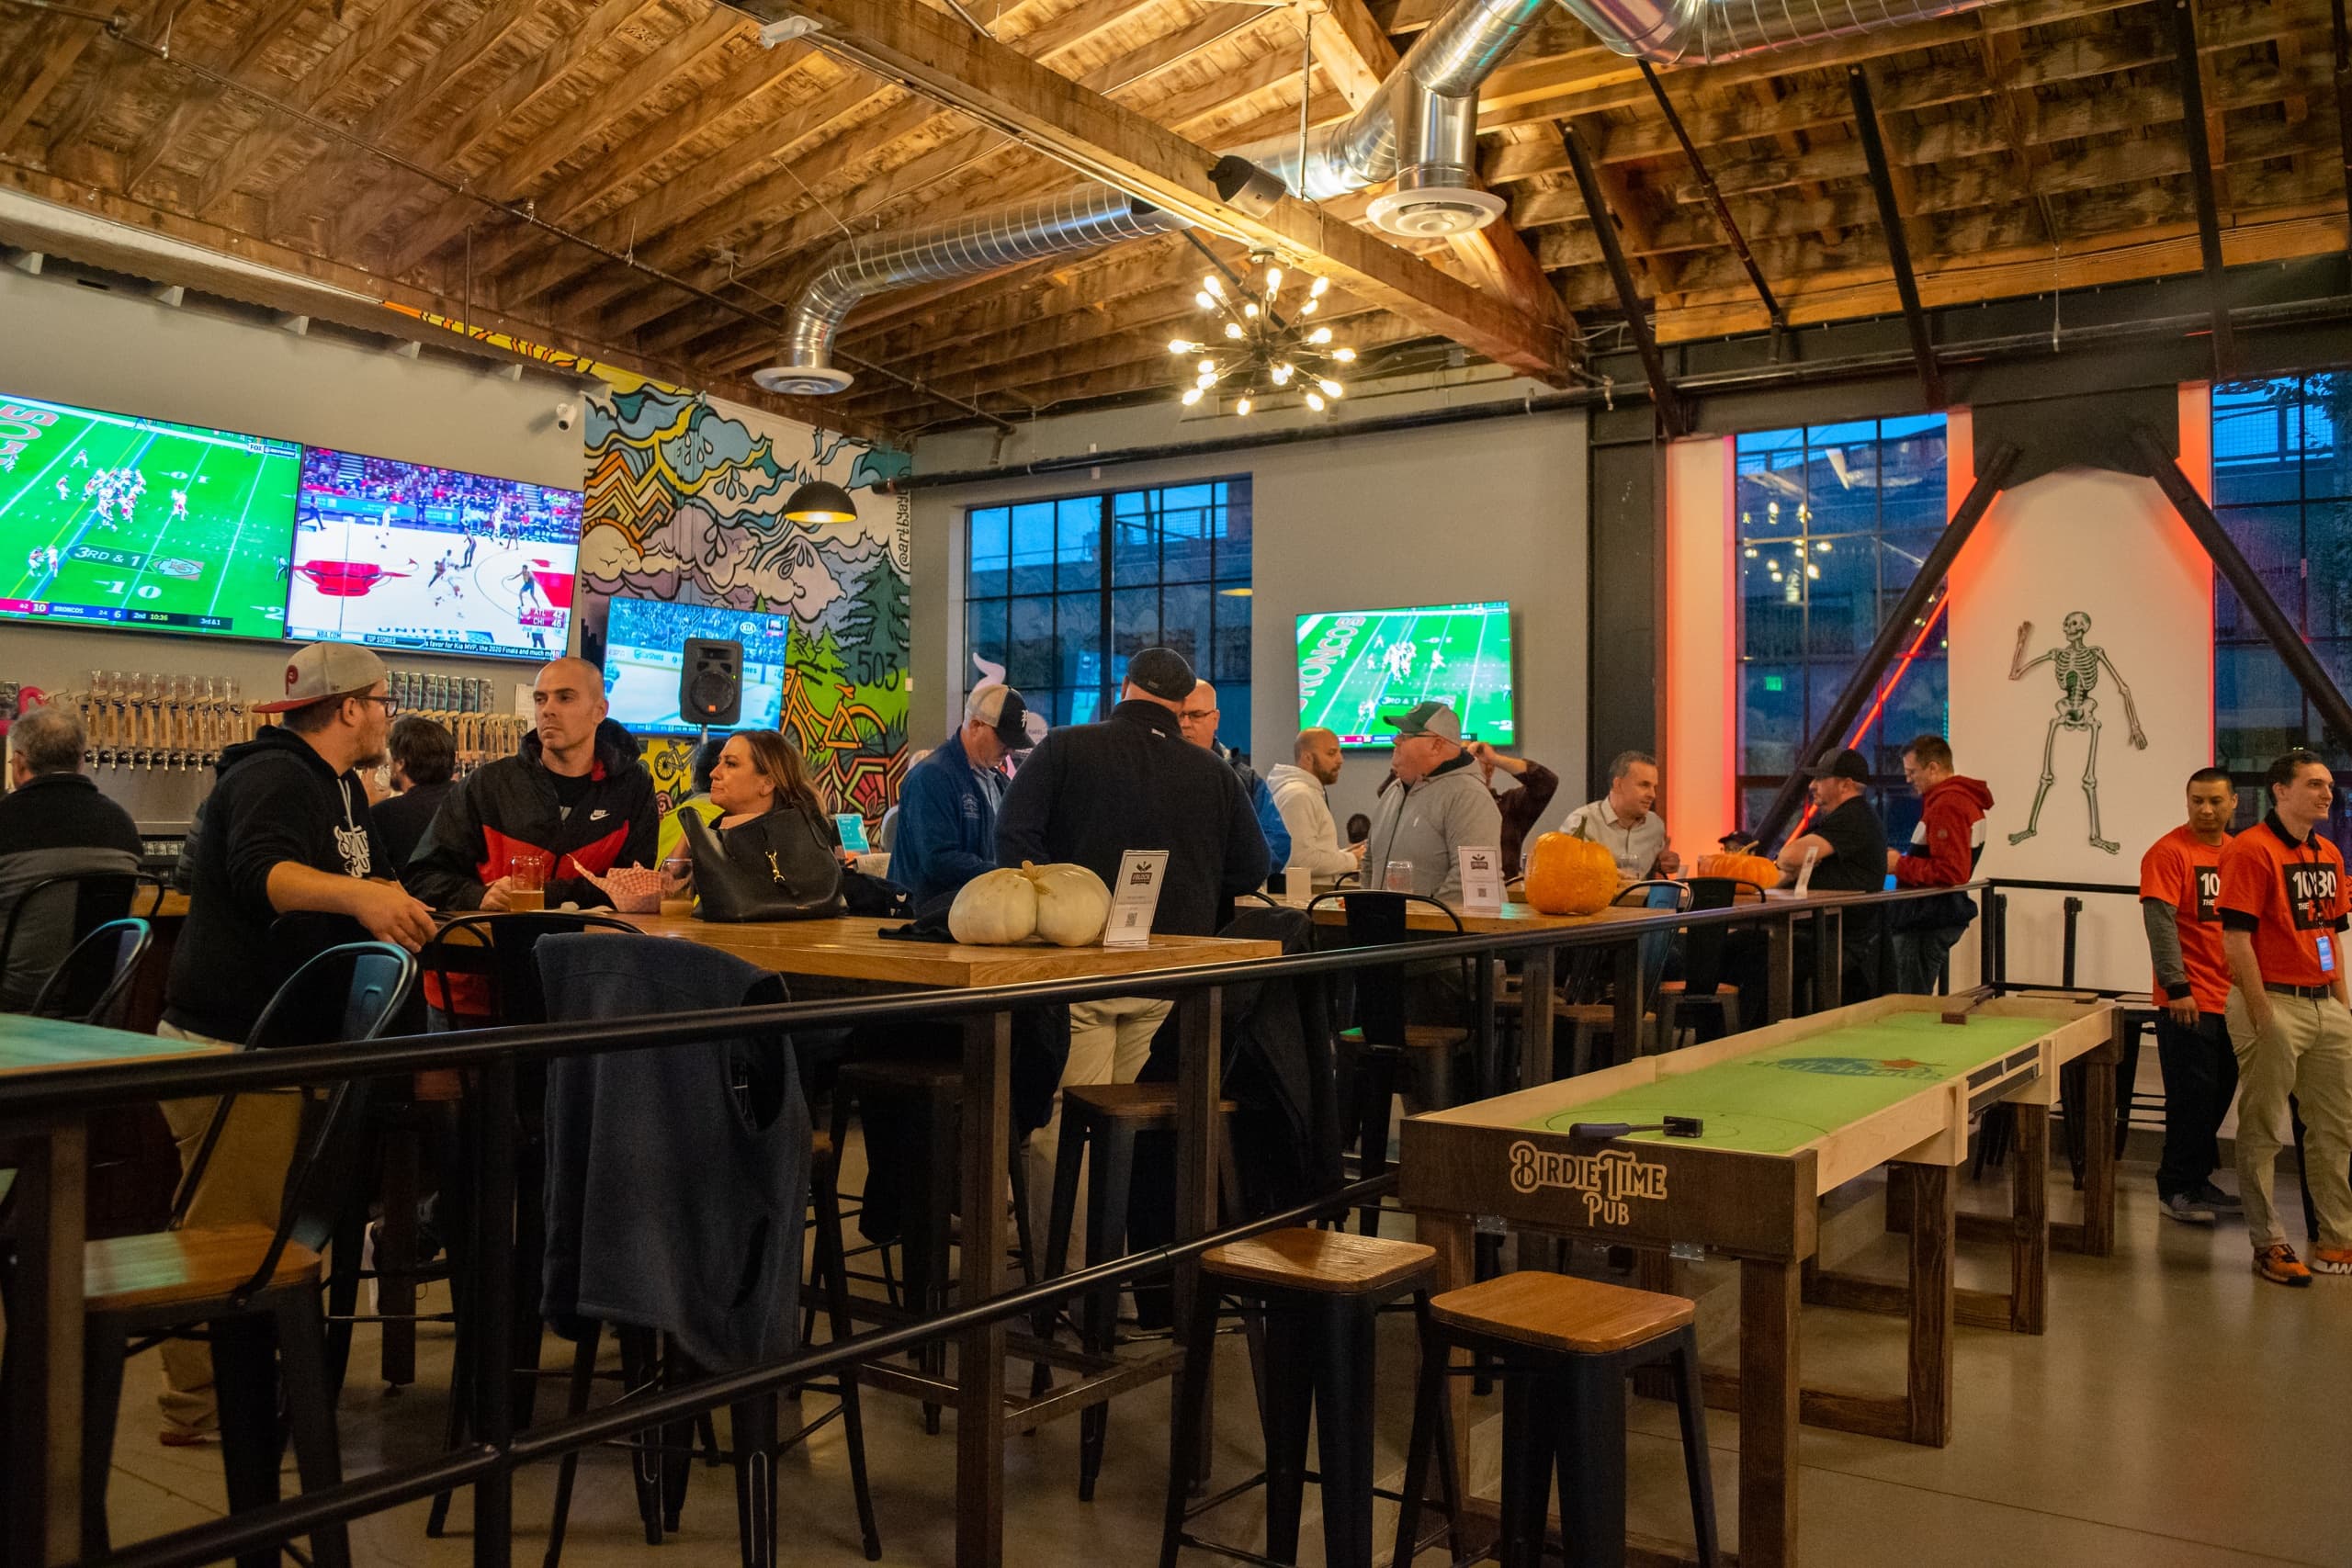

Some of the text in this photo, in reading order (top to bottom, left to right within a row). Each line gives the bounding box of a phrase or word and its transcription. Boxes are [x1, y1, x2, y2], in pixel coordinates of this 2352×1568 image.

[897, 490, 910, 567] @artbyay
[74, 547, 141, 567] 3RD & 1
[32, 603, 47, 612] 10
[53, 605, 84, 615] BRONCOS
[114, 610, 121, 619] 6
[533, 616, 545, 626] CHI
[316, 630, 342, 640] NBA.COM
[857, 650, 899, 692] 503
[2298, 902, 2310, 910] THE
